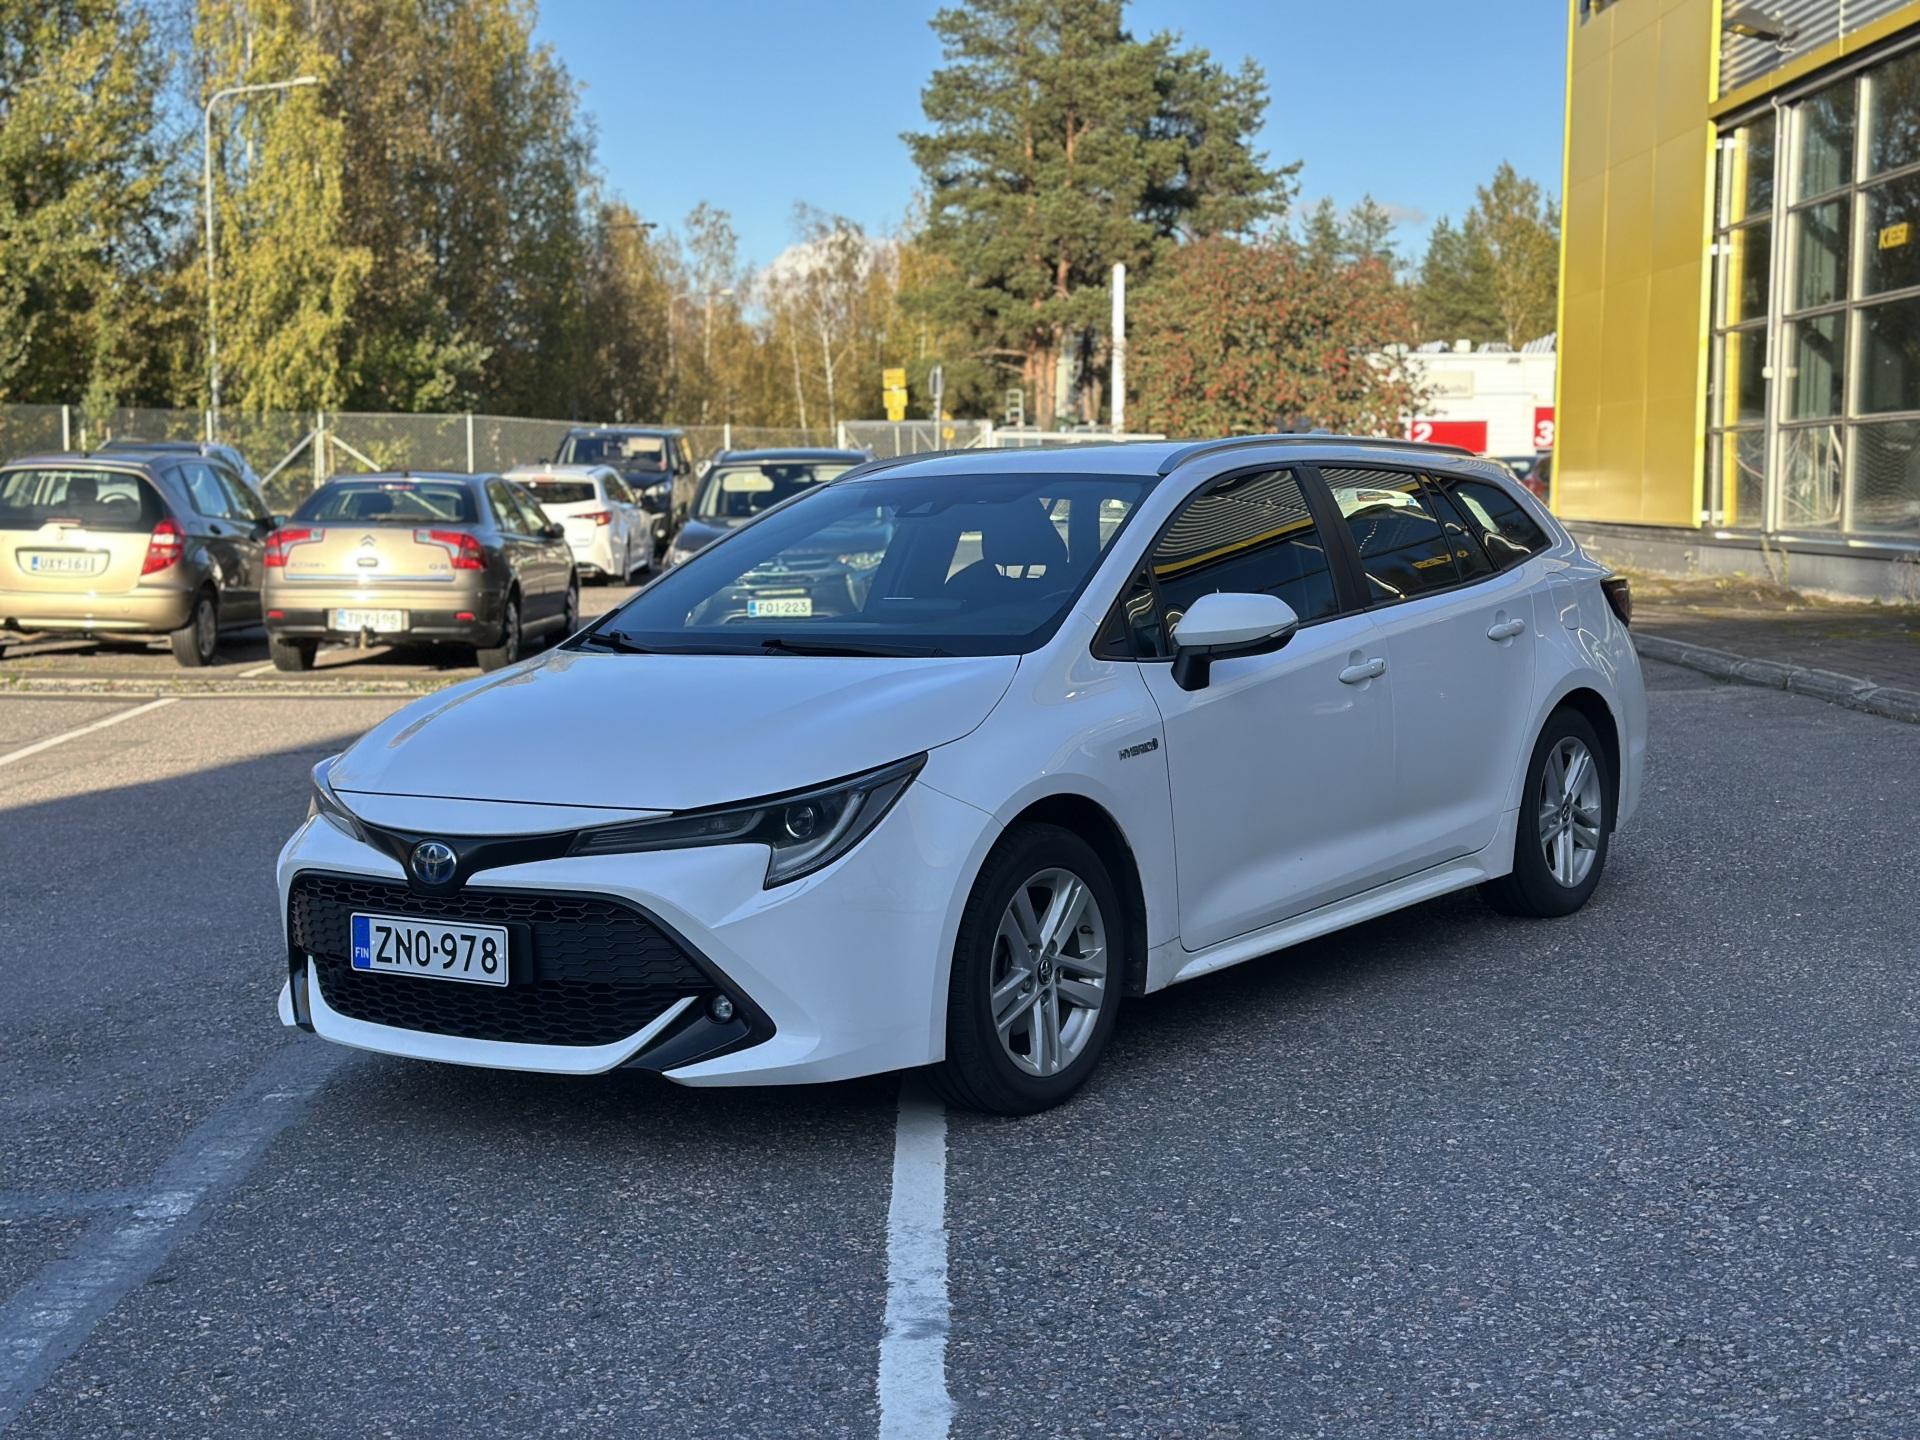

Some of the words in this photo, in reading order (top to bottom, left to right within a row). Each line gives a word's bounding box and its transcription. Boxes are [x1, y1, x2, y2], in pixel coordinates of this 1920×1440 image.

[1413, 423, 1432, 443] 2
[1535, 420, 1554, 446] 3
[355, 947, 369, 958] FIN
[375, 926, 498, 975] ZNO-978
